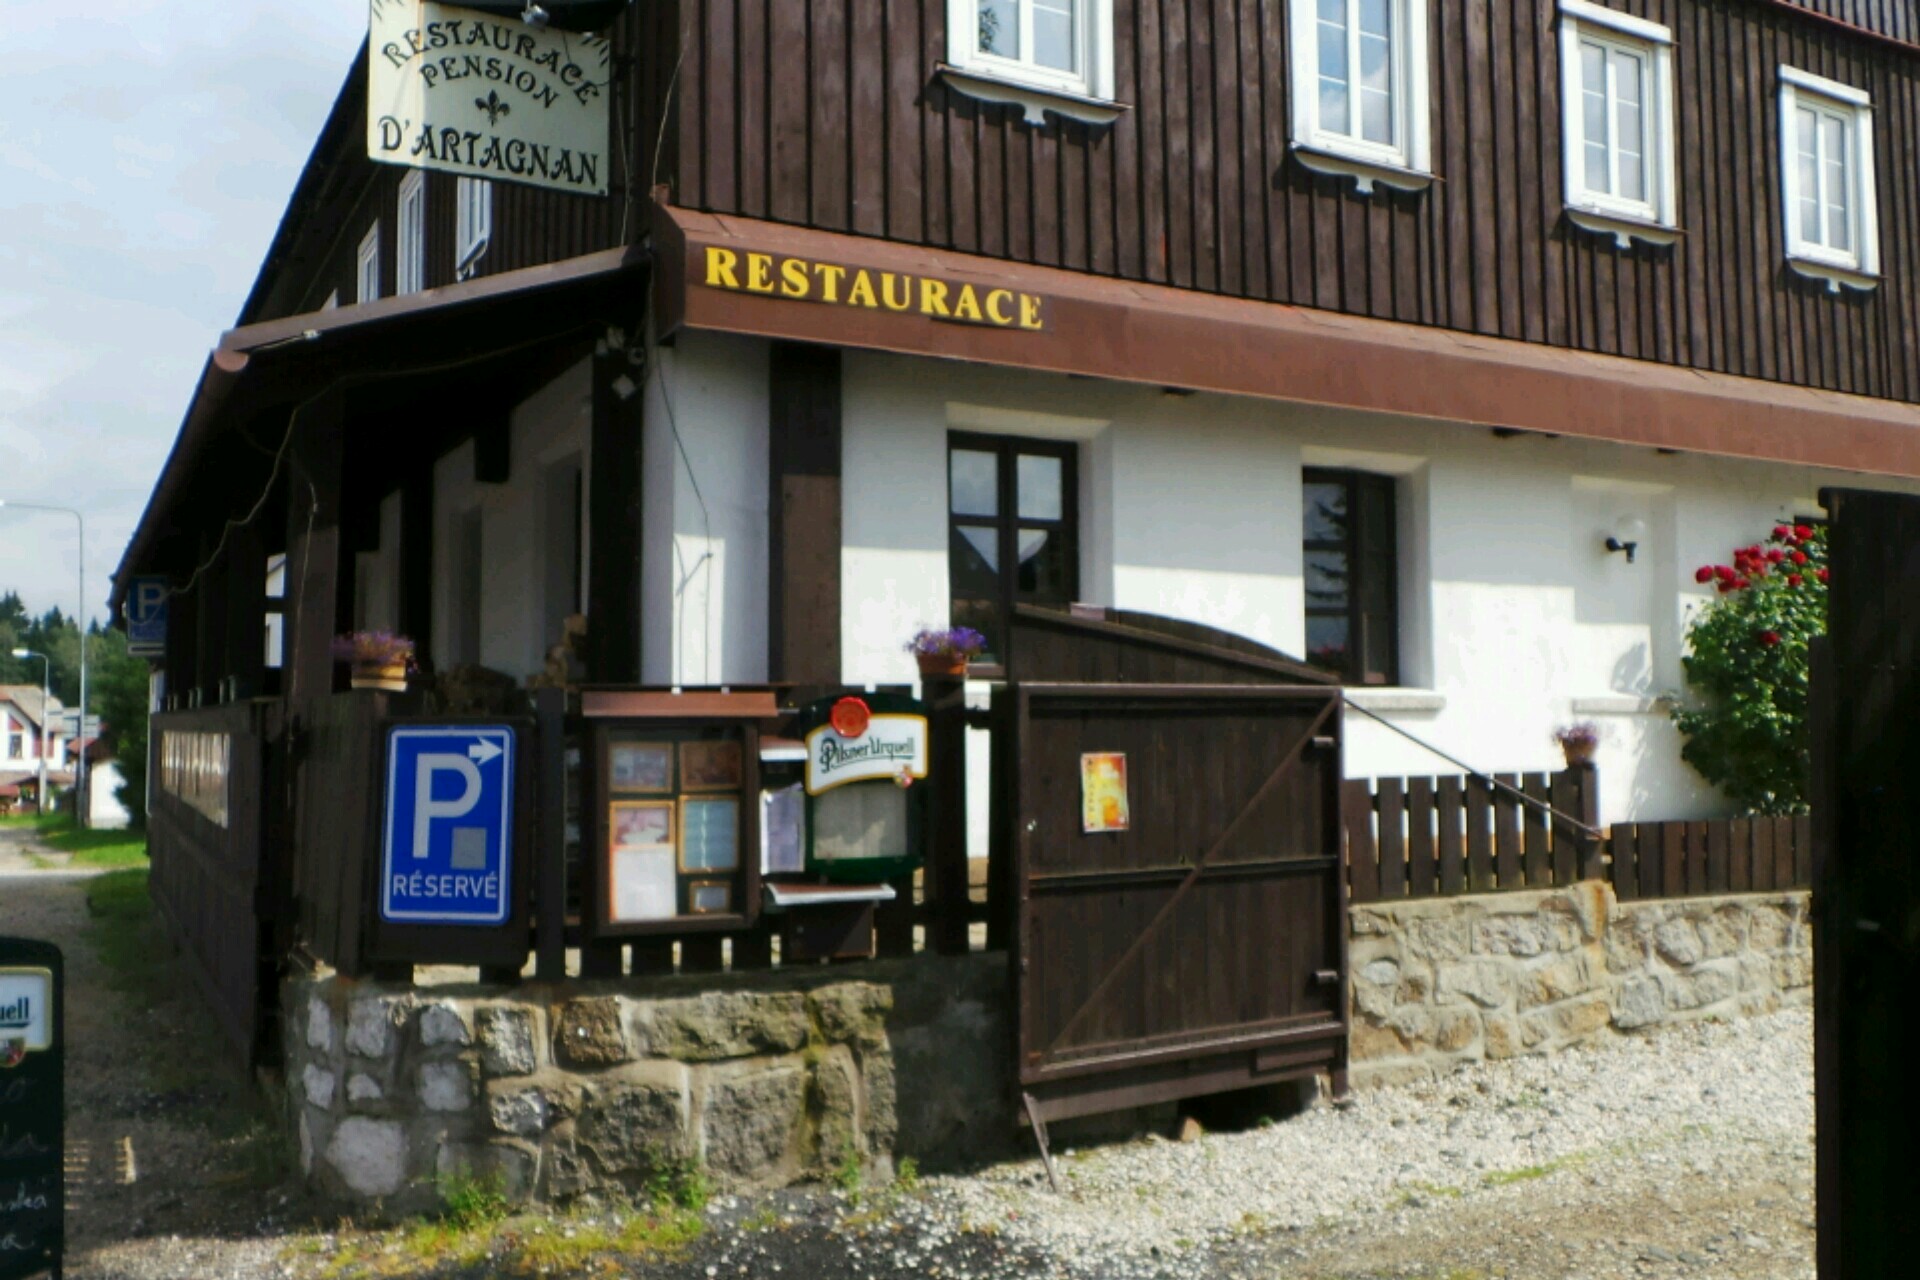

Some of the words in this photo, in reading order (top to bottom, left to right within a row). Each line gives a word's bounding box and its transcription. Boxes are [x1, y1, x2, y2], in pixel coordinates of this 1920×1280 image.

[382, 20, 600, 106] RESTAURACE
[418, 55, 560, 108] PENSION
[377, 115, 599, 186] D'ARTAGNAN
[704, 247, 1043, 329] RESTAURACE
[820, 737, 869, 774] Pilsner
[413, 753, 482, 858] P
[393, 870, 498, 898] RÉSERVÉ
